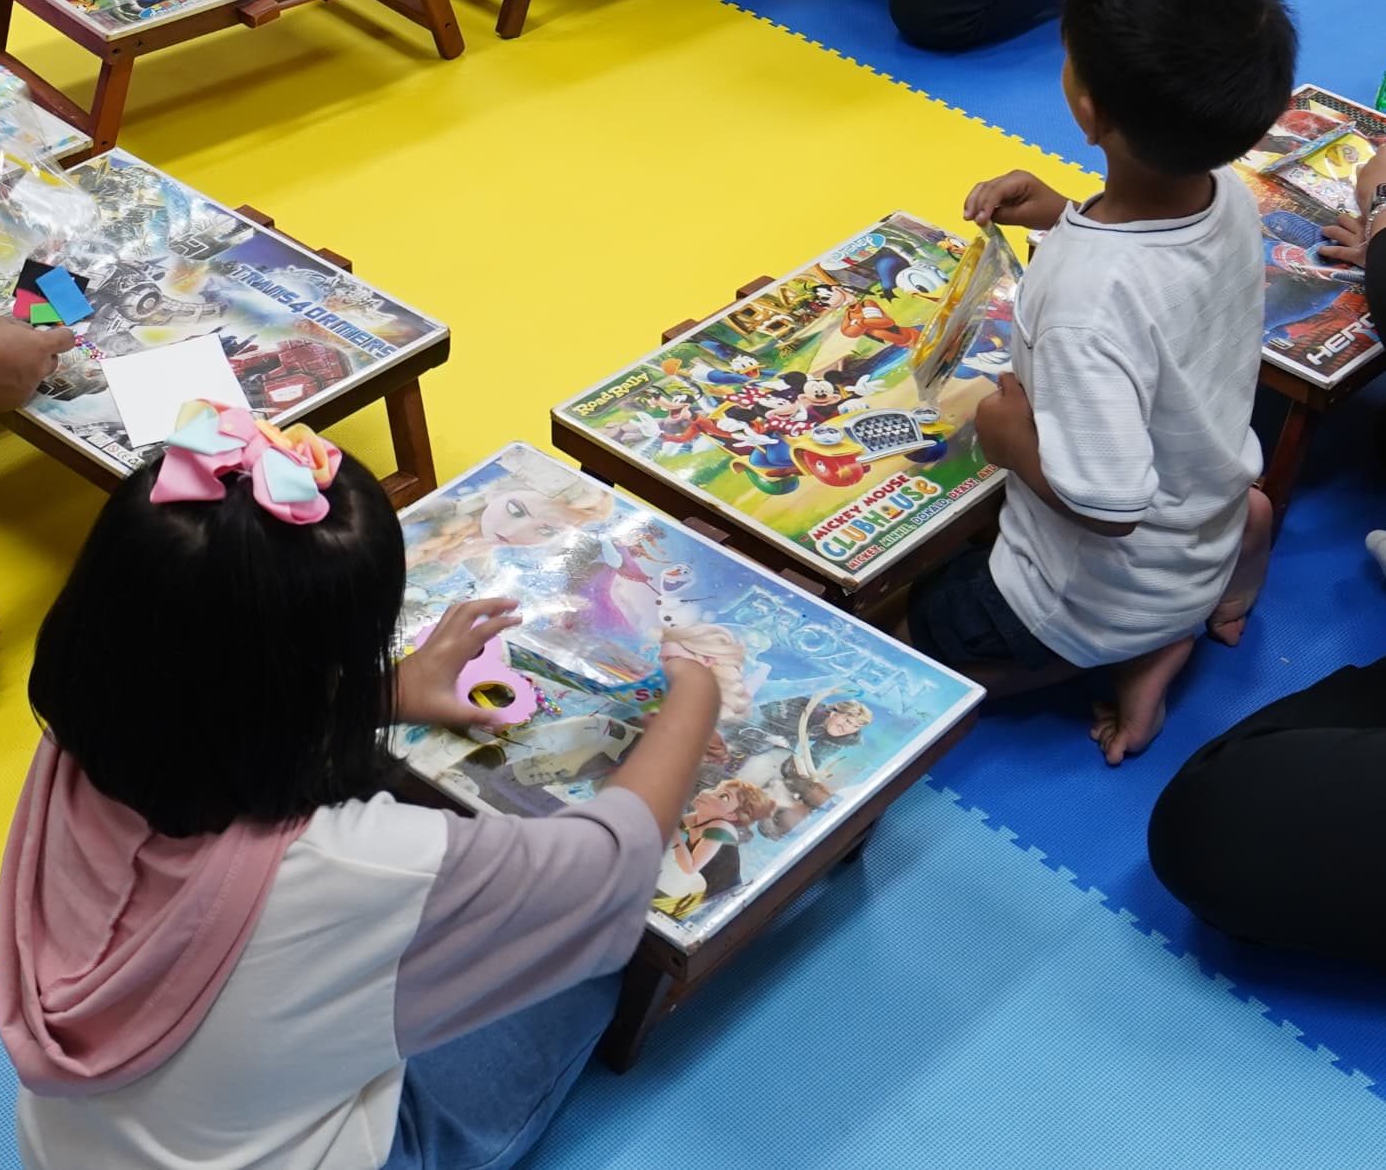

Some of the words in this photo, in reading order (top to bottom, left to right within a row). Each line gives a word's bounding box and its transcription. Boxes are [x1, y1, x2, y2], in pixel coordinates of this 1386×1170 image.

[573, 390, 614, 417] Road
[609, 372, 650, 399] Rally
[812, 505, 863, 541] MICKEY
[862, 474, 911, 508] MOUSE
[846, 544, 885, 571] MICKEY,
[912, 498, 952, 526] DONALD,
[718, 584, 940, 716] FROZEN
